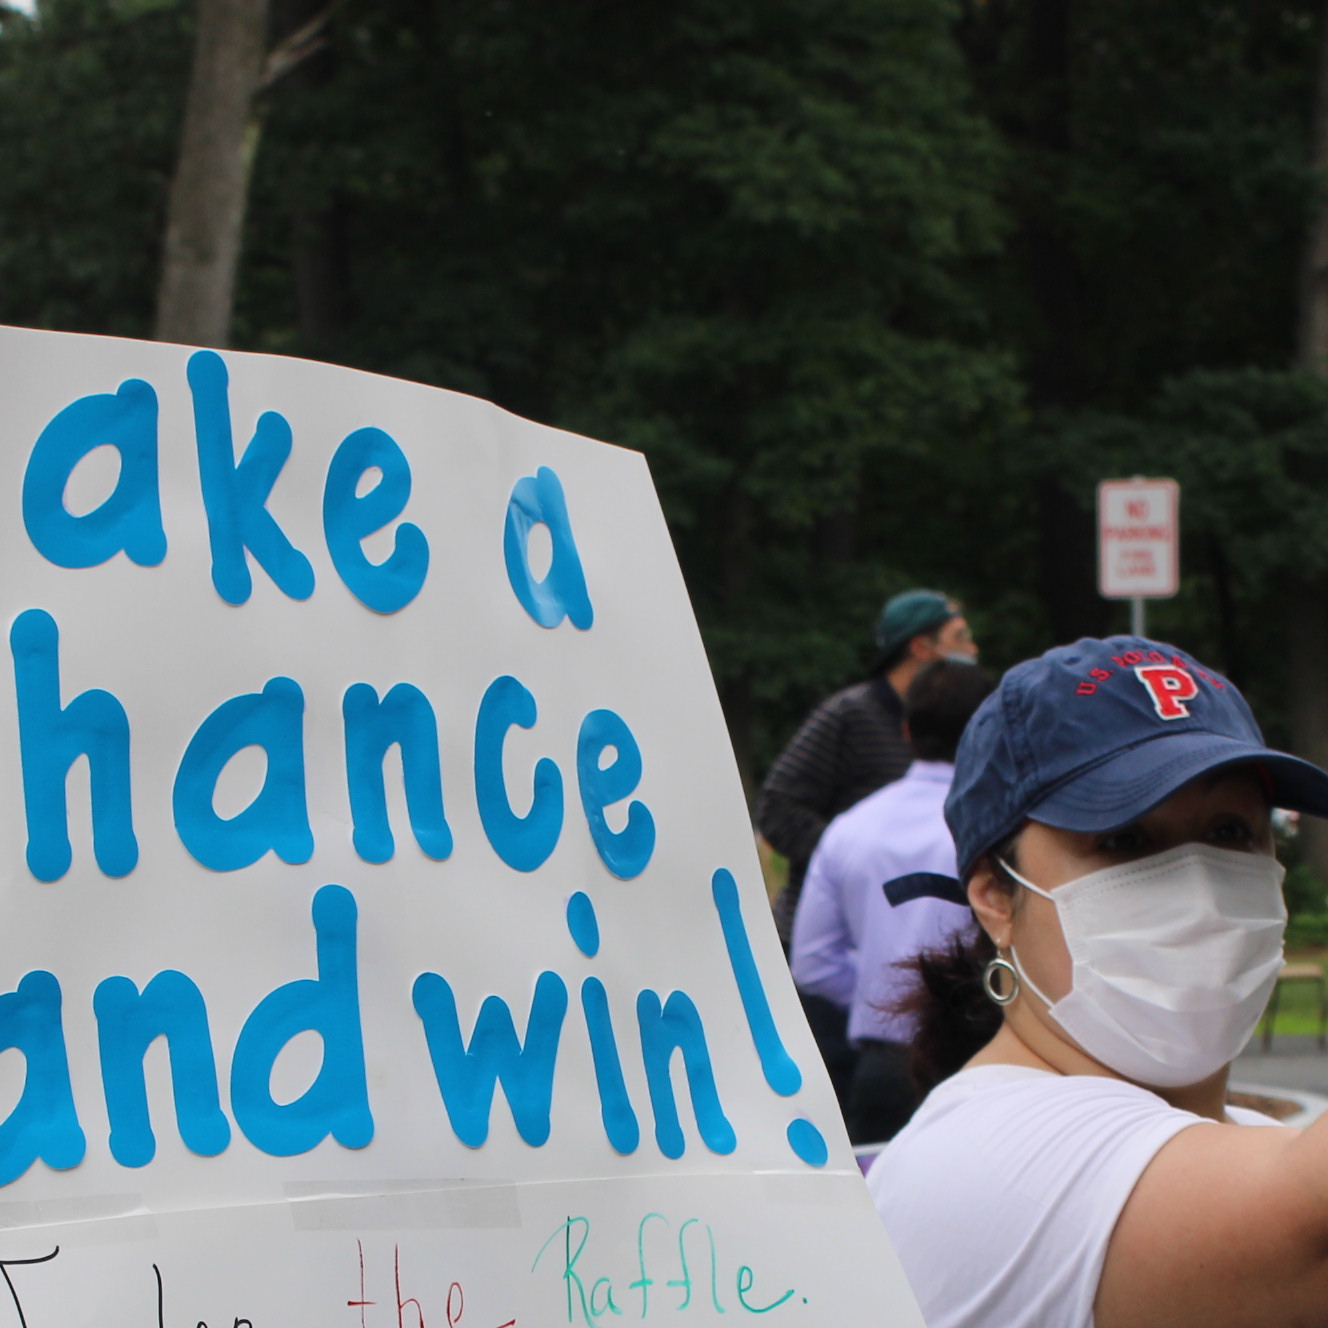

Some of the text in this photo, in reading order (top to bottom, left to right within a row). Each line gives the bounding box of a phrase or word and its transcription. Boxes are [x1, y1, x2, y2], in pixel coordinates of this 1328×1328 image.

[503, 466, 594, 631] a
[1134, 664, 1199, 721] P
[412, 868, 829, 1167] win!
